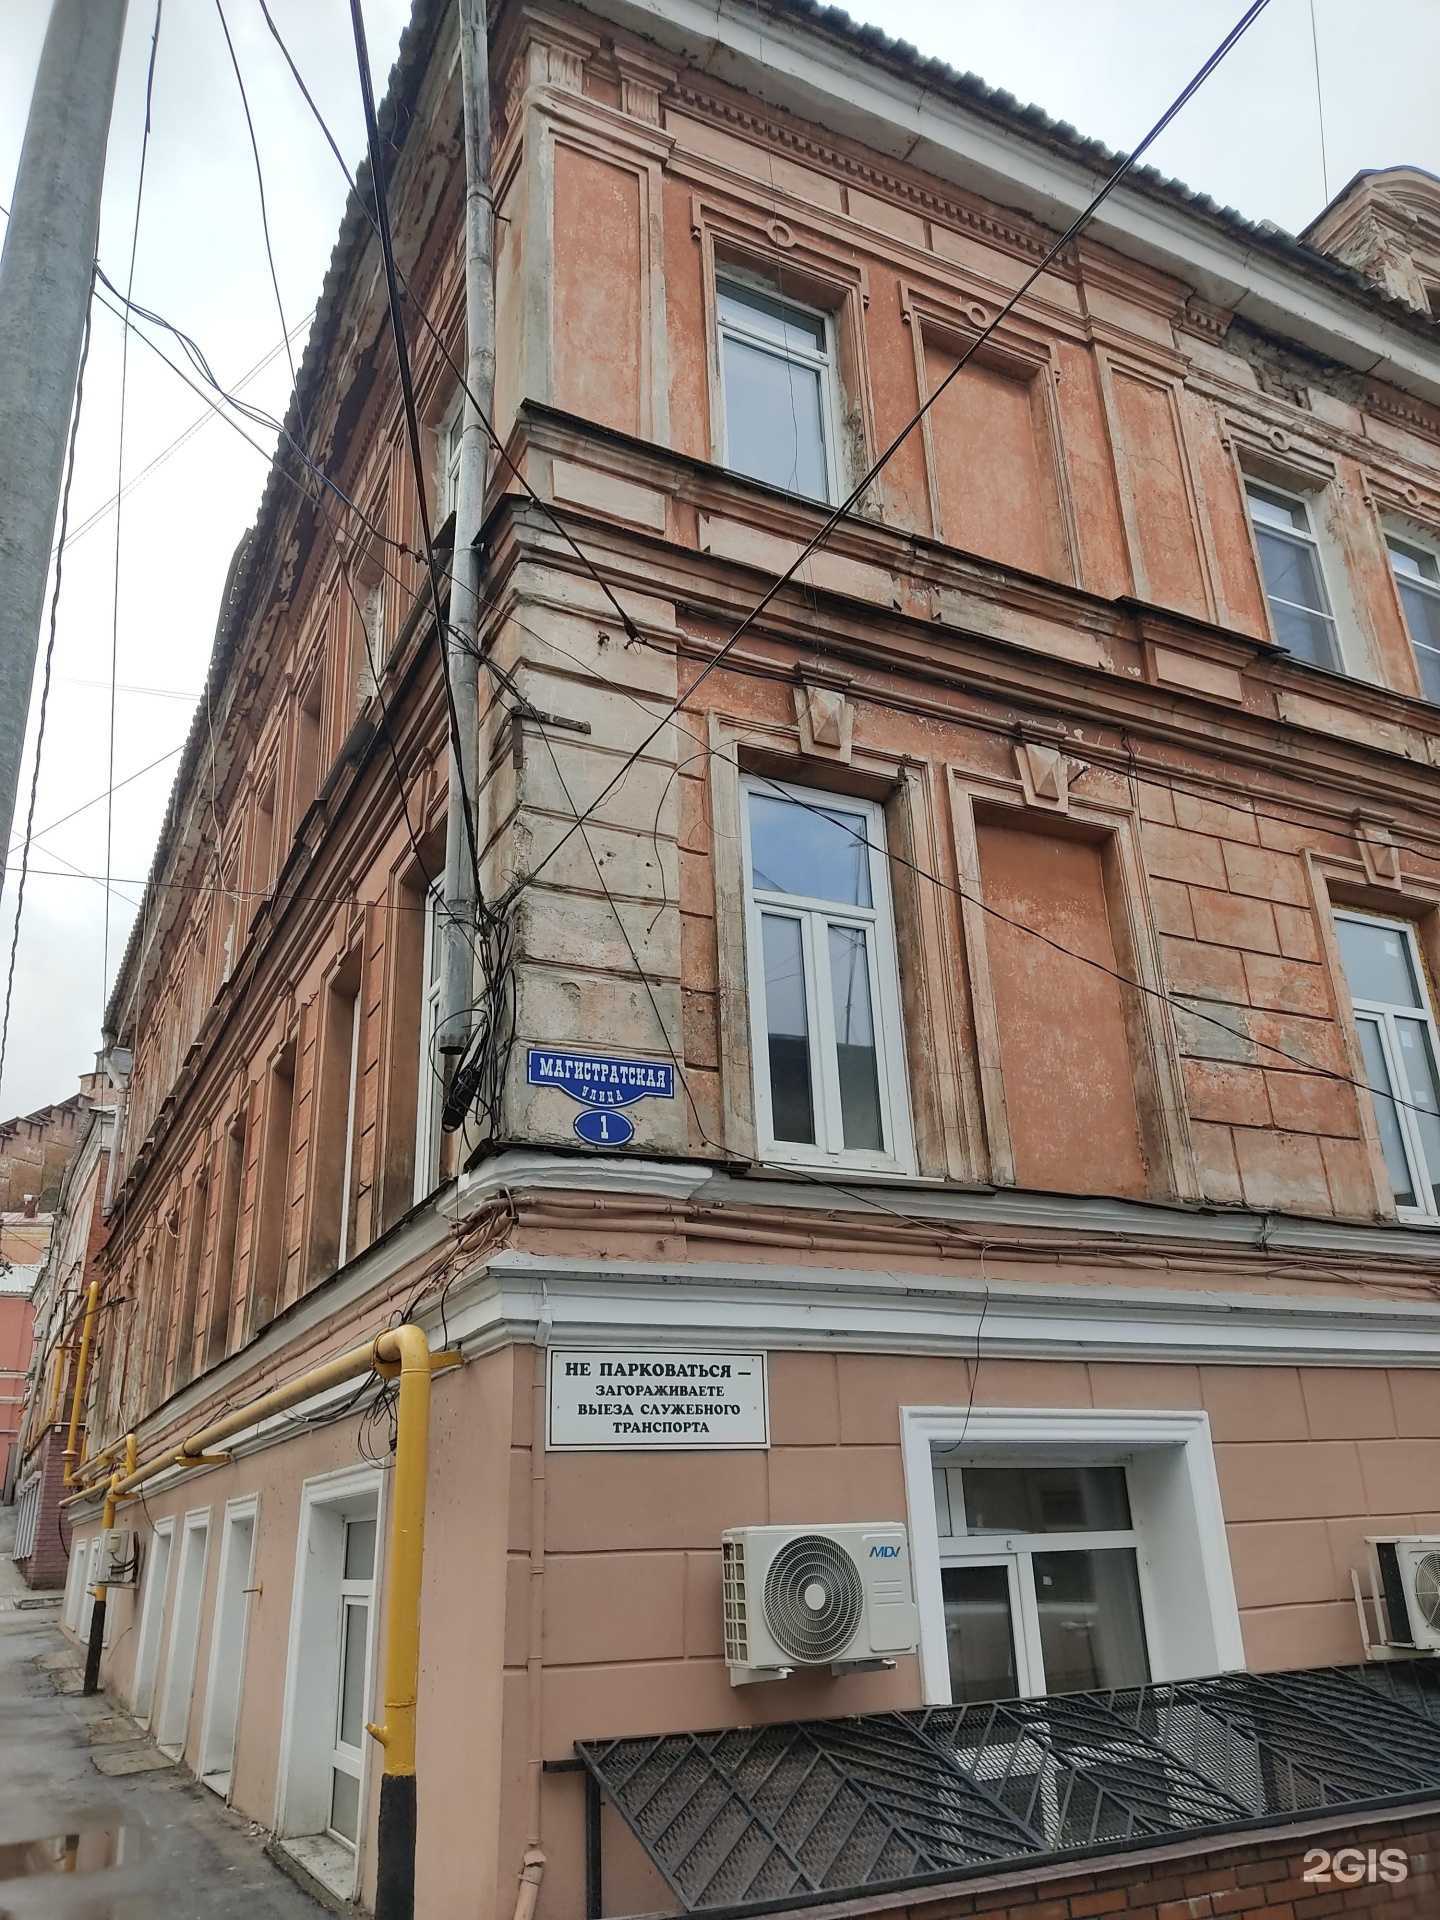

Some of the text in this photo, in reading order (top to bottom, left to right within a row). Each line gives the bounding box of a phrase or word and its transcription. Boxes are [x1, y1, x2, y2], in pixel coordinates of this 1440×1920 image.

[539, 1057, 666, 1089] МАГИСТРАТСКАЯ
[600, 1115, 609, 1140] 1
[565, 1362, 592, 1377] НЕ
[599, 1362, 732, 1378] ПАРКОВАТЬСЯ
[595, 1385, 725, 1397] ЗАГОРАЖИВАЕТЕ
[577, 1403, 741, 1416] ВЫЕЗД СЛУЖЕБНОГО
[612, 1421, 710, 1434] ТРАНСПОРТА
[869, 1546, 902, 1558] MDV
